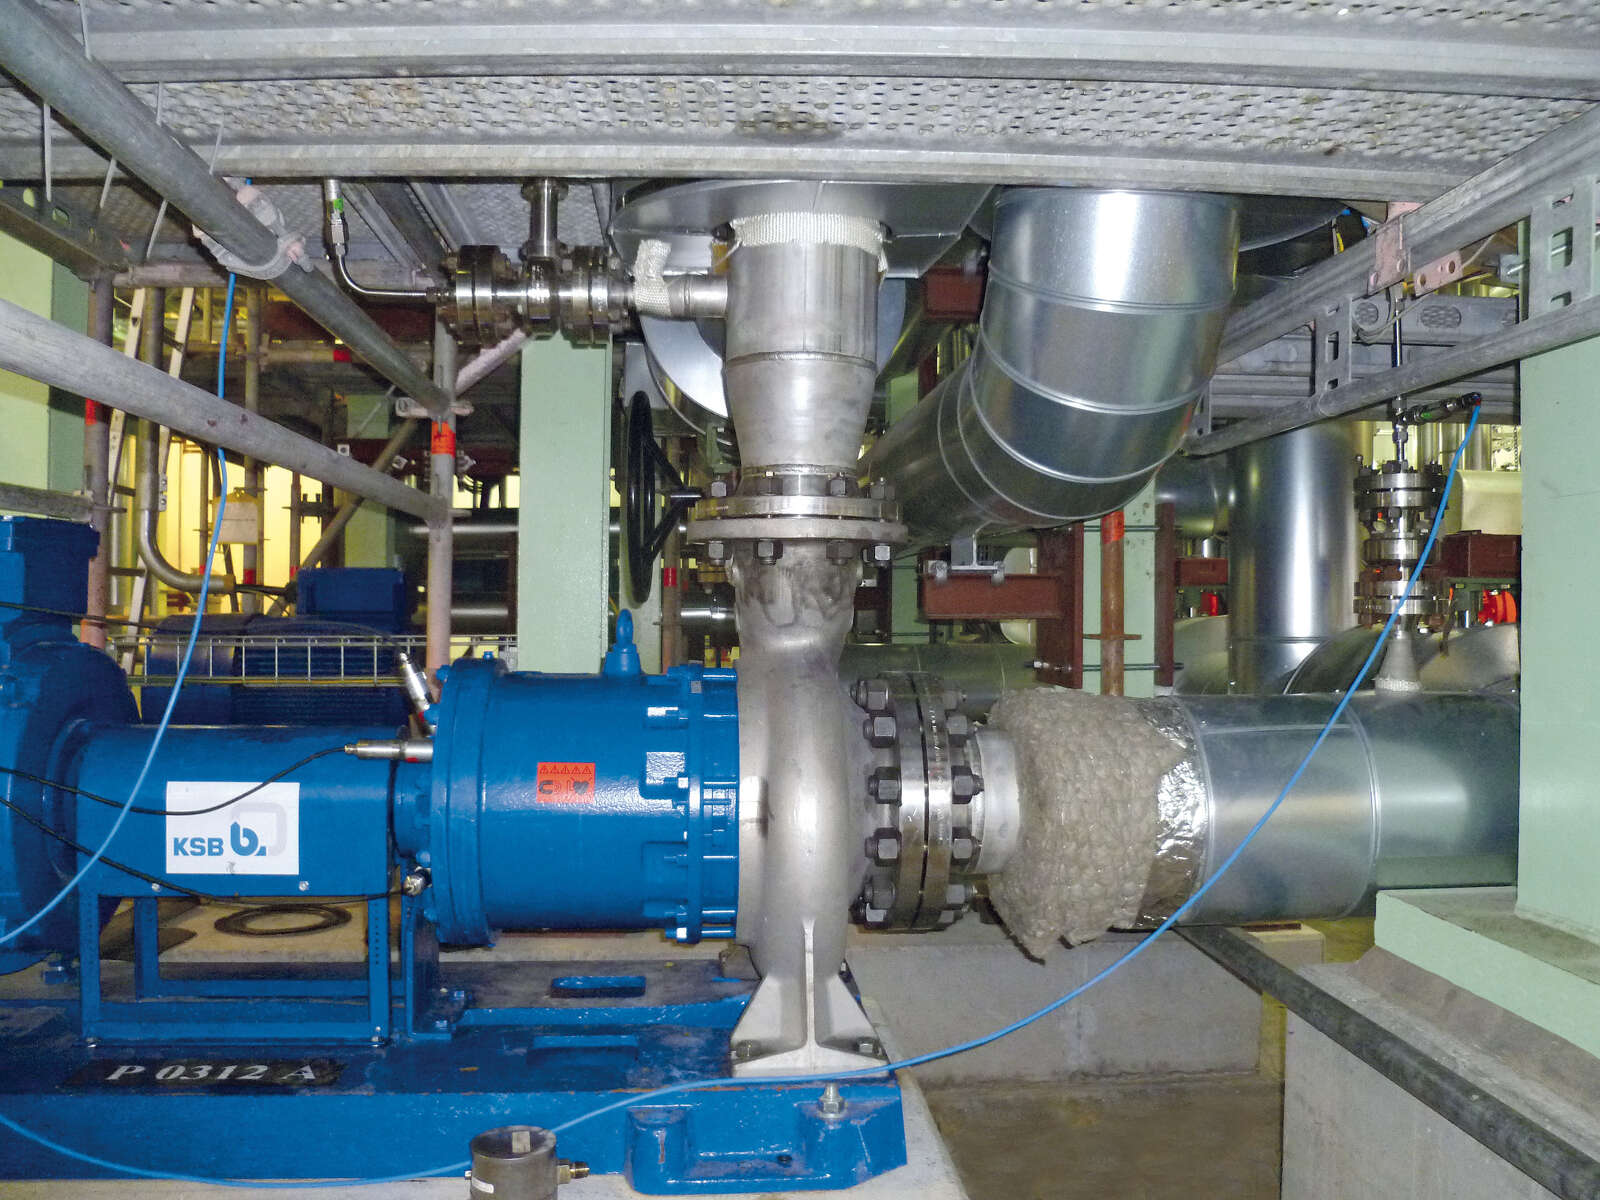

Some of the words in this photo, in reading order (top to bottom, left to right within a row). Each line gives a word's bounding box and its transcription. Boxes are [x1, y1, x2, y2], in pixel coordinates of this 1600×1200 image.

[173, 837, 224, 857] KSB
[105, 1064, 146, 1081] P
[154, 1064, 269, 1081] 0312
[280, 1064, 317, 1081] A
